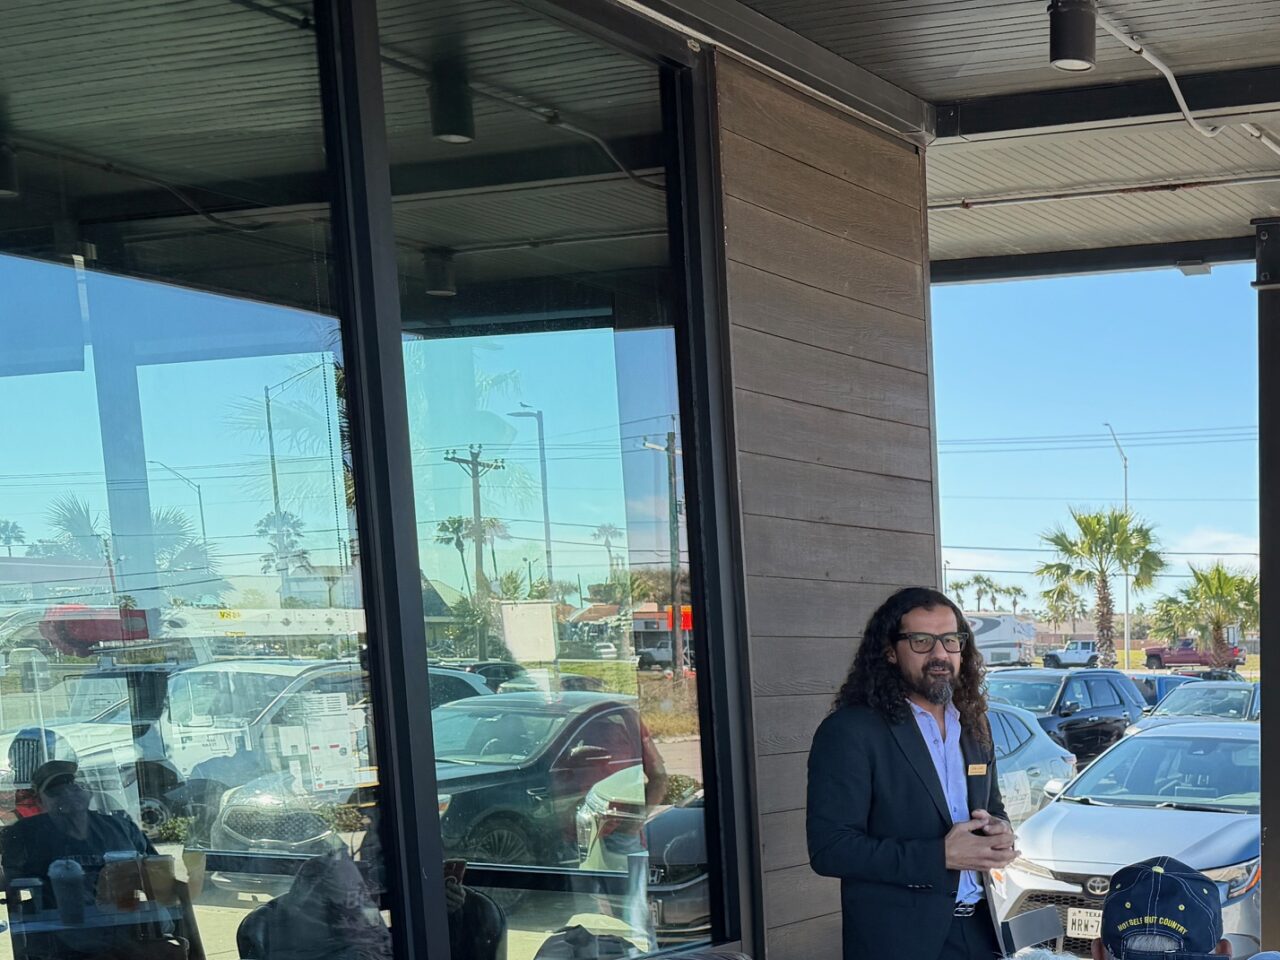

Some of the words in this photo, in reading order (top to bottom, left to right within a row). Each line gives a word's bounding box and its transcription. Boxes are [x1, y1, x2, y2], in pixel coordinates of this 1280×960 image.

[1129, 917, 1143, 926] SELF
[1144, 916, 1158, 924] BUT
[1158, 917, 1188, 935] COUNTRY
